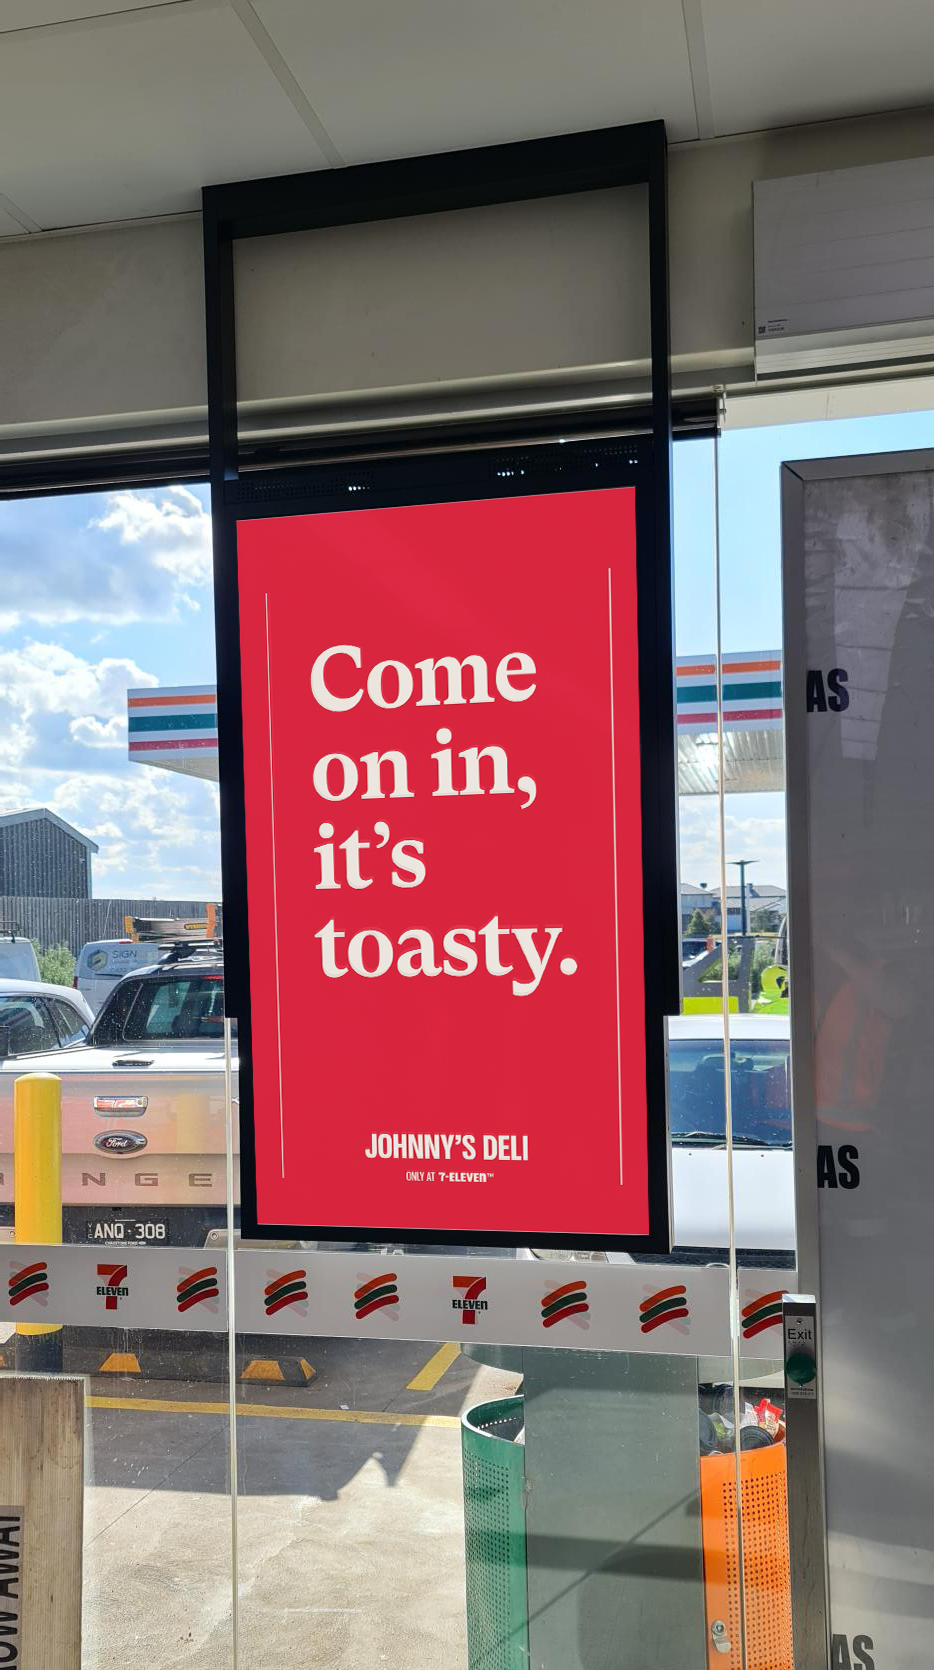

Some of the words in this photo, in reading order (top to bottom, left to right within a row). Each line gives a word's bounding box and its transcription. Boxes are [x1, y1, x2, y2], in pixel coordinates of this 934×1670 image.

[310, 645, 537, 712] Come
[313, 750, 415, 801] on
[430, 728, 537, 809] in,
[314, 821, 426, 889] it’s
[112, 949, 137, 959] SIGN
[314, 915, 578, 996] toasty.
[105, 1137, 129, 1148] Ford
[364, 1133, 477, 1160] JOHNNY’S
[483, 1135, 529, 1161] DELI
[0, 1172, 213, 1187] NGE
[406, 1171, 425, 1182] ONLY
[426, 1172, 435, 1182] AT
[97, 1264, 128, 1310] 7
[452, 1276, 487, 1324] 7
[787, 1328, 813, 1340] Exit
